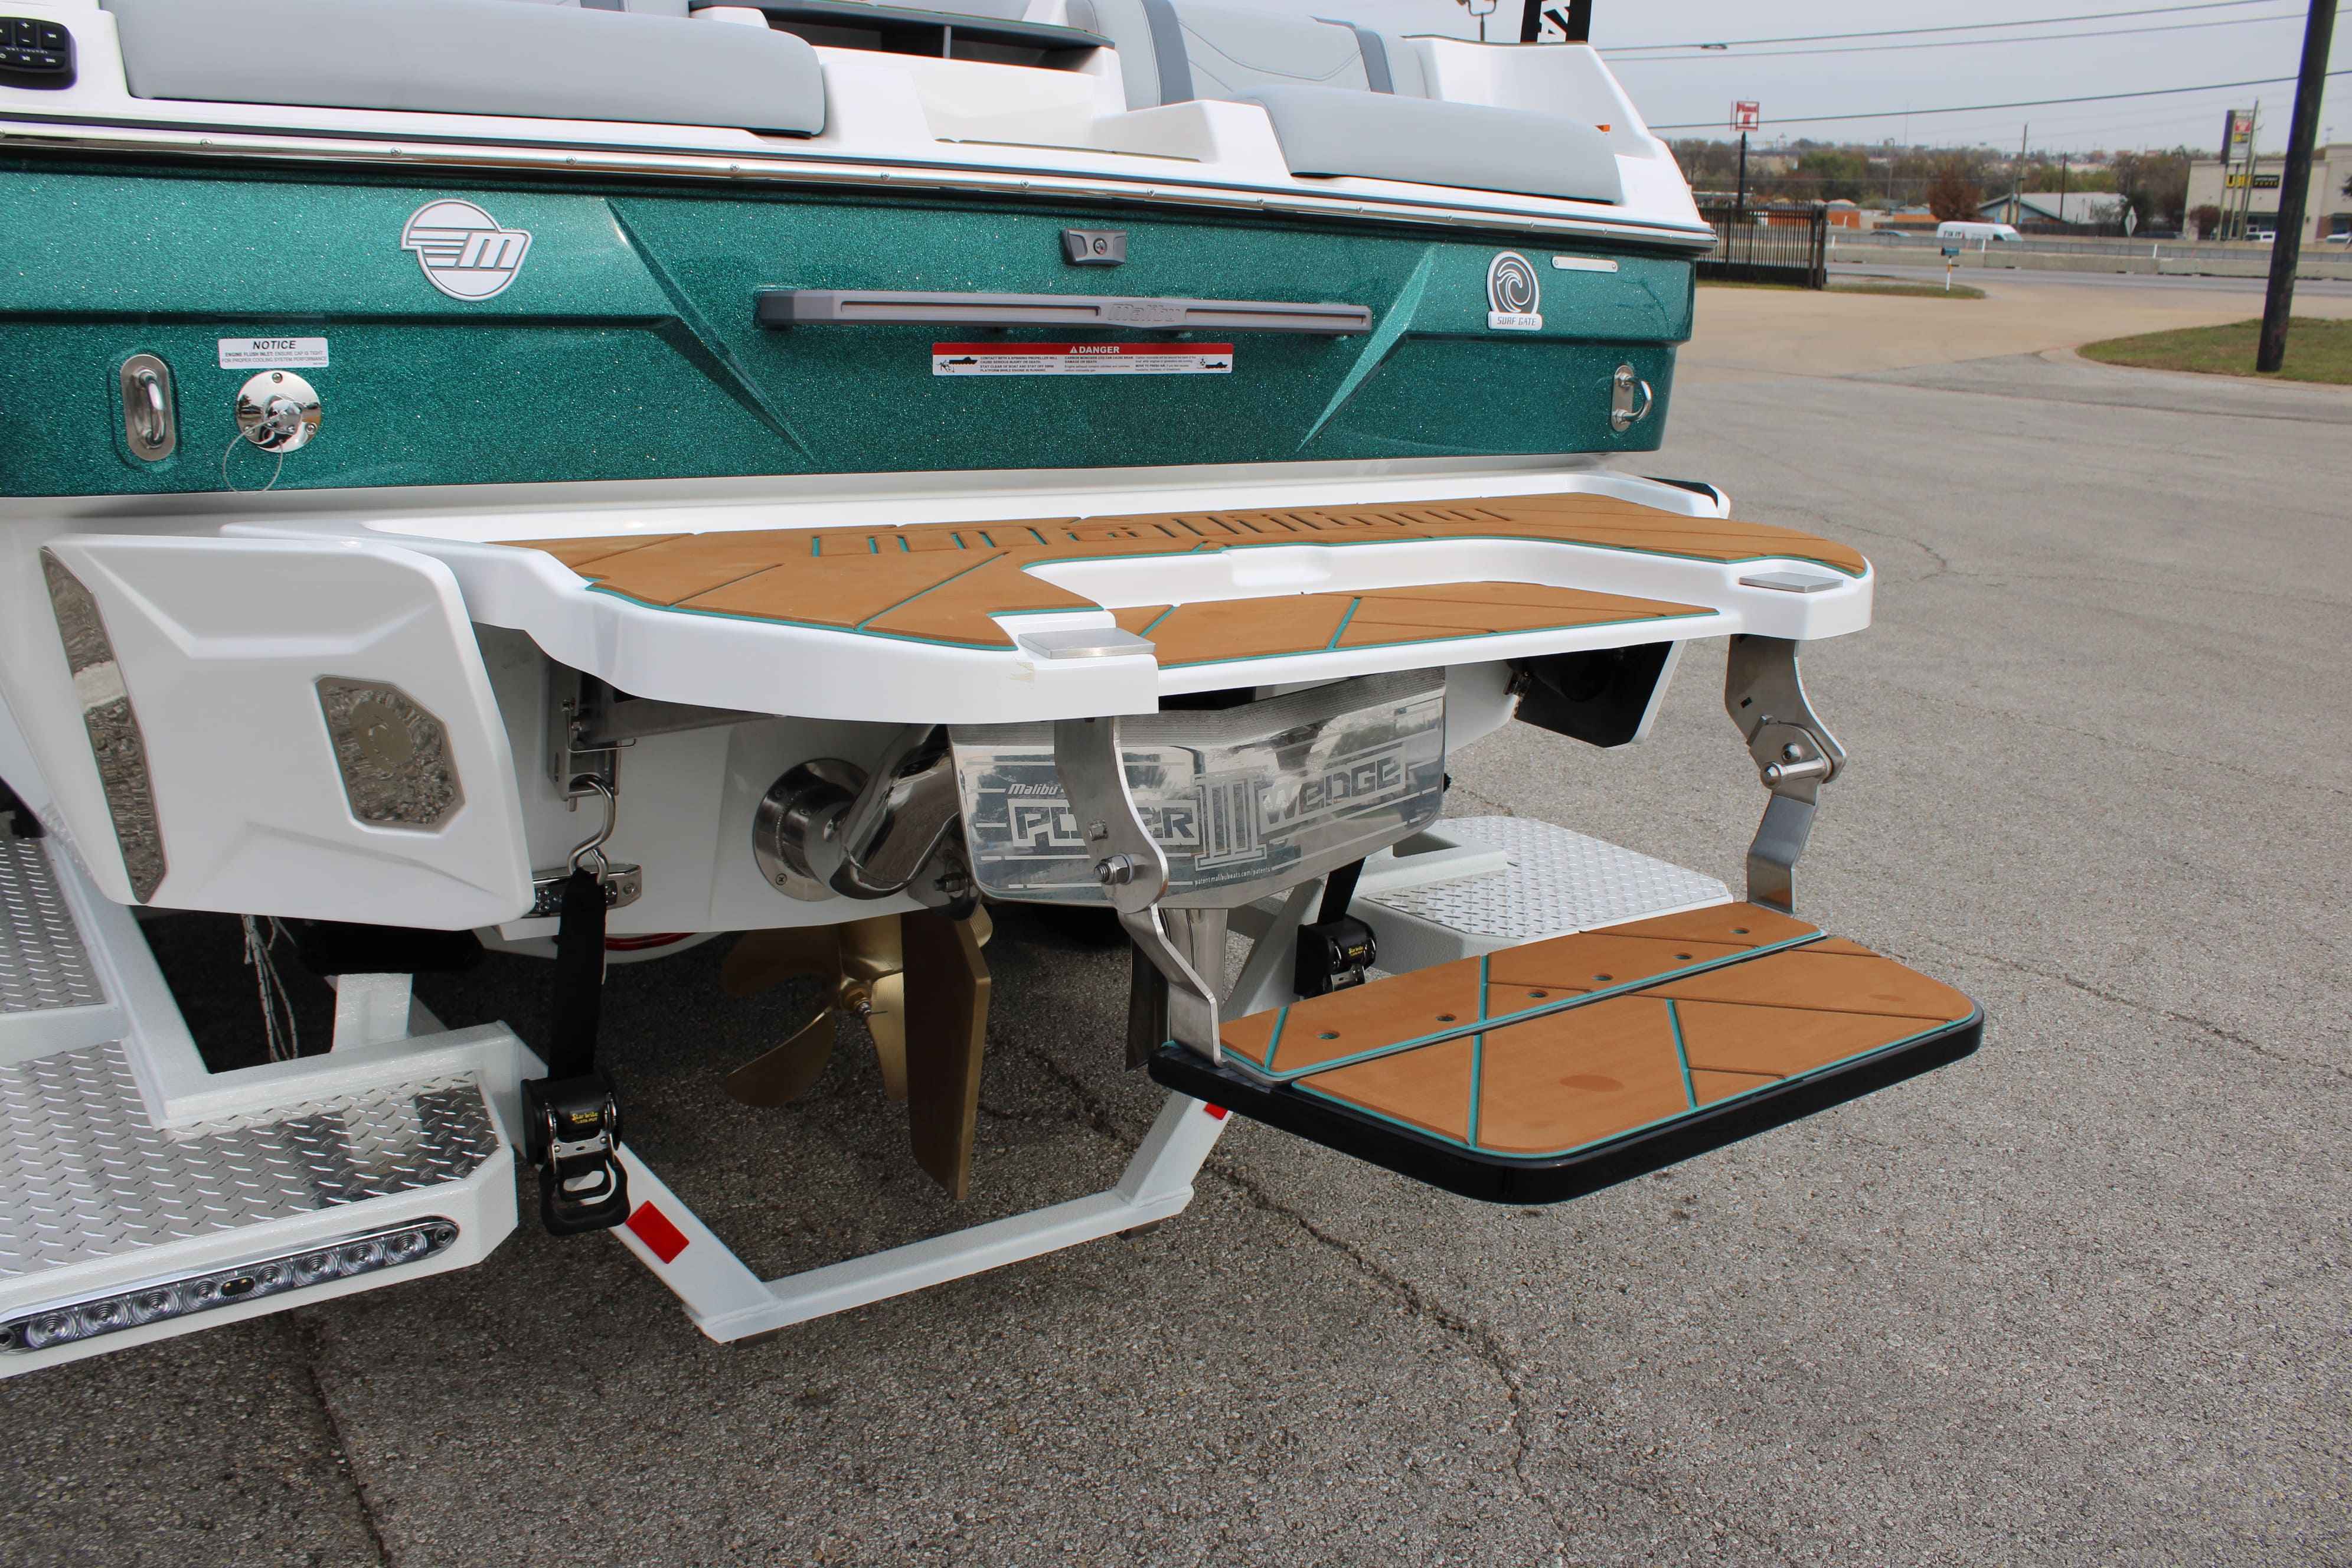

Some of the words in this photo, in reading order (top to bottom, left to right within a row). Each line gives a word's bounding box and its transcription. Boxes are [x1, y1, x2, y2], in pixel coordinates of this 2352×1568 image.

[1108, 303, 1181, 322] Malibu
[1497, 316, 1517, 325] SURF
[1518, 316, 1536, 326] GATE
[253, 340, 296, 349] NOTICE
[1007, 783, 1061, 795] Malibu
[1012, 804, 1197, 843] POER
